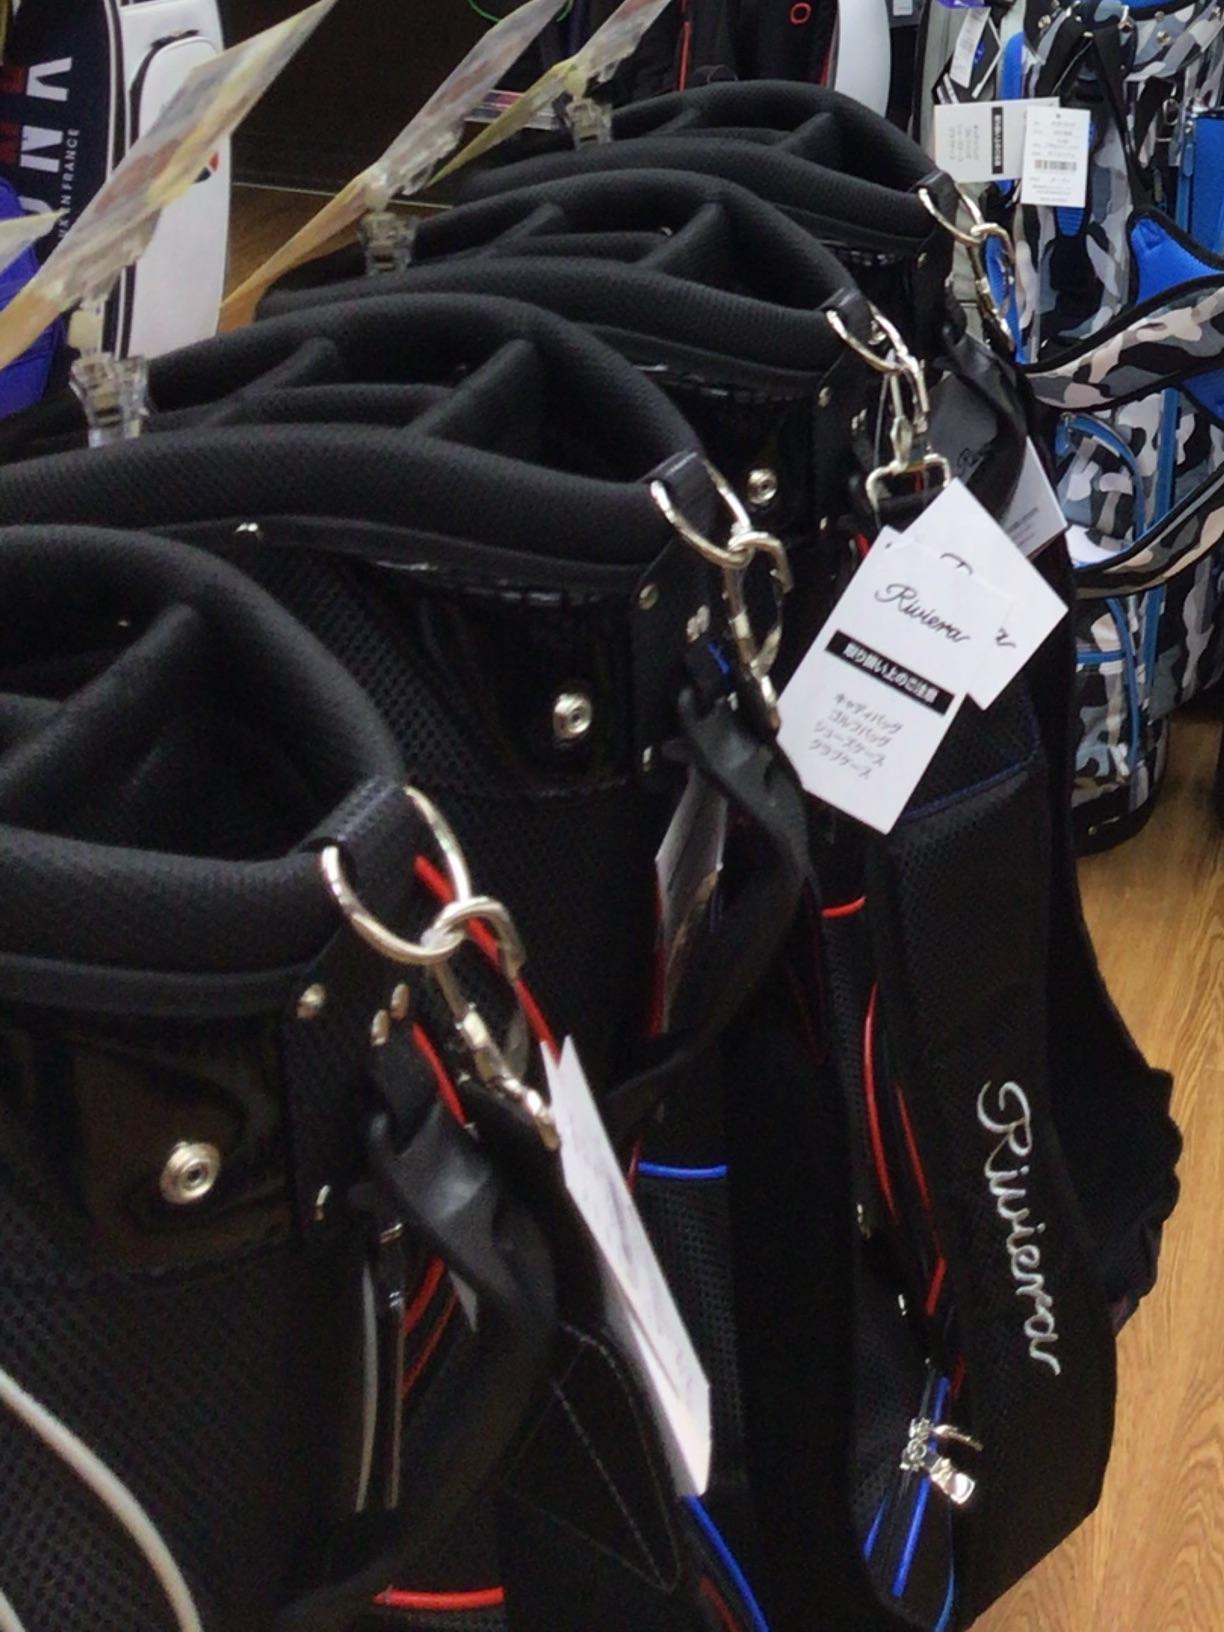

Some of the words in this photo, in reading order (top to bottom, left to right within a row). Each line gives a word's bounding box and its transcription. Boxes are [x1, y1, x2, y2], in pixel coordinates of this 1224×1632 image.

[61, 128, 81, 190] FRANCE
[873, 582, 972, 644] Riviera
[975, 1079, 1063, 1378] Riviera
